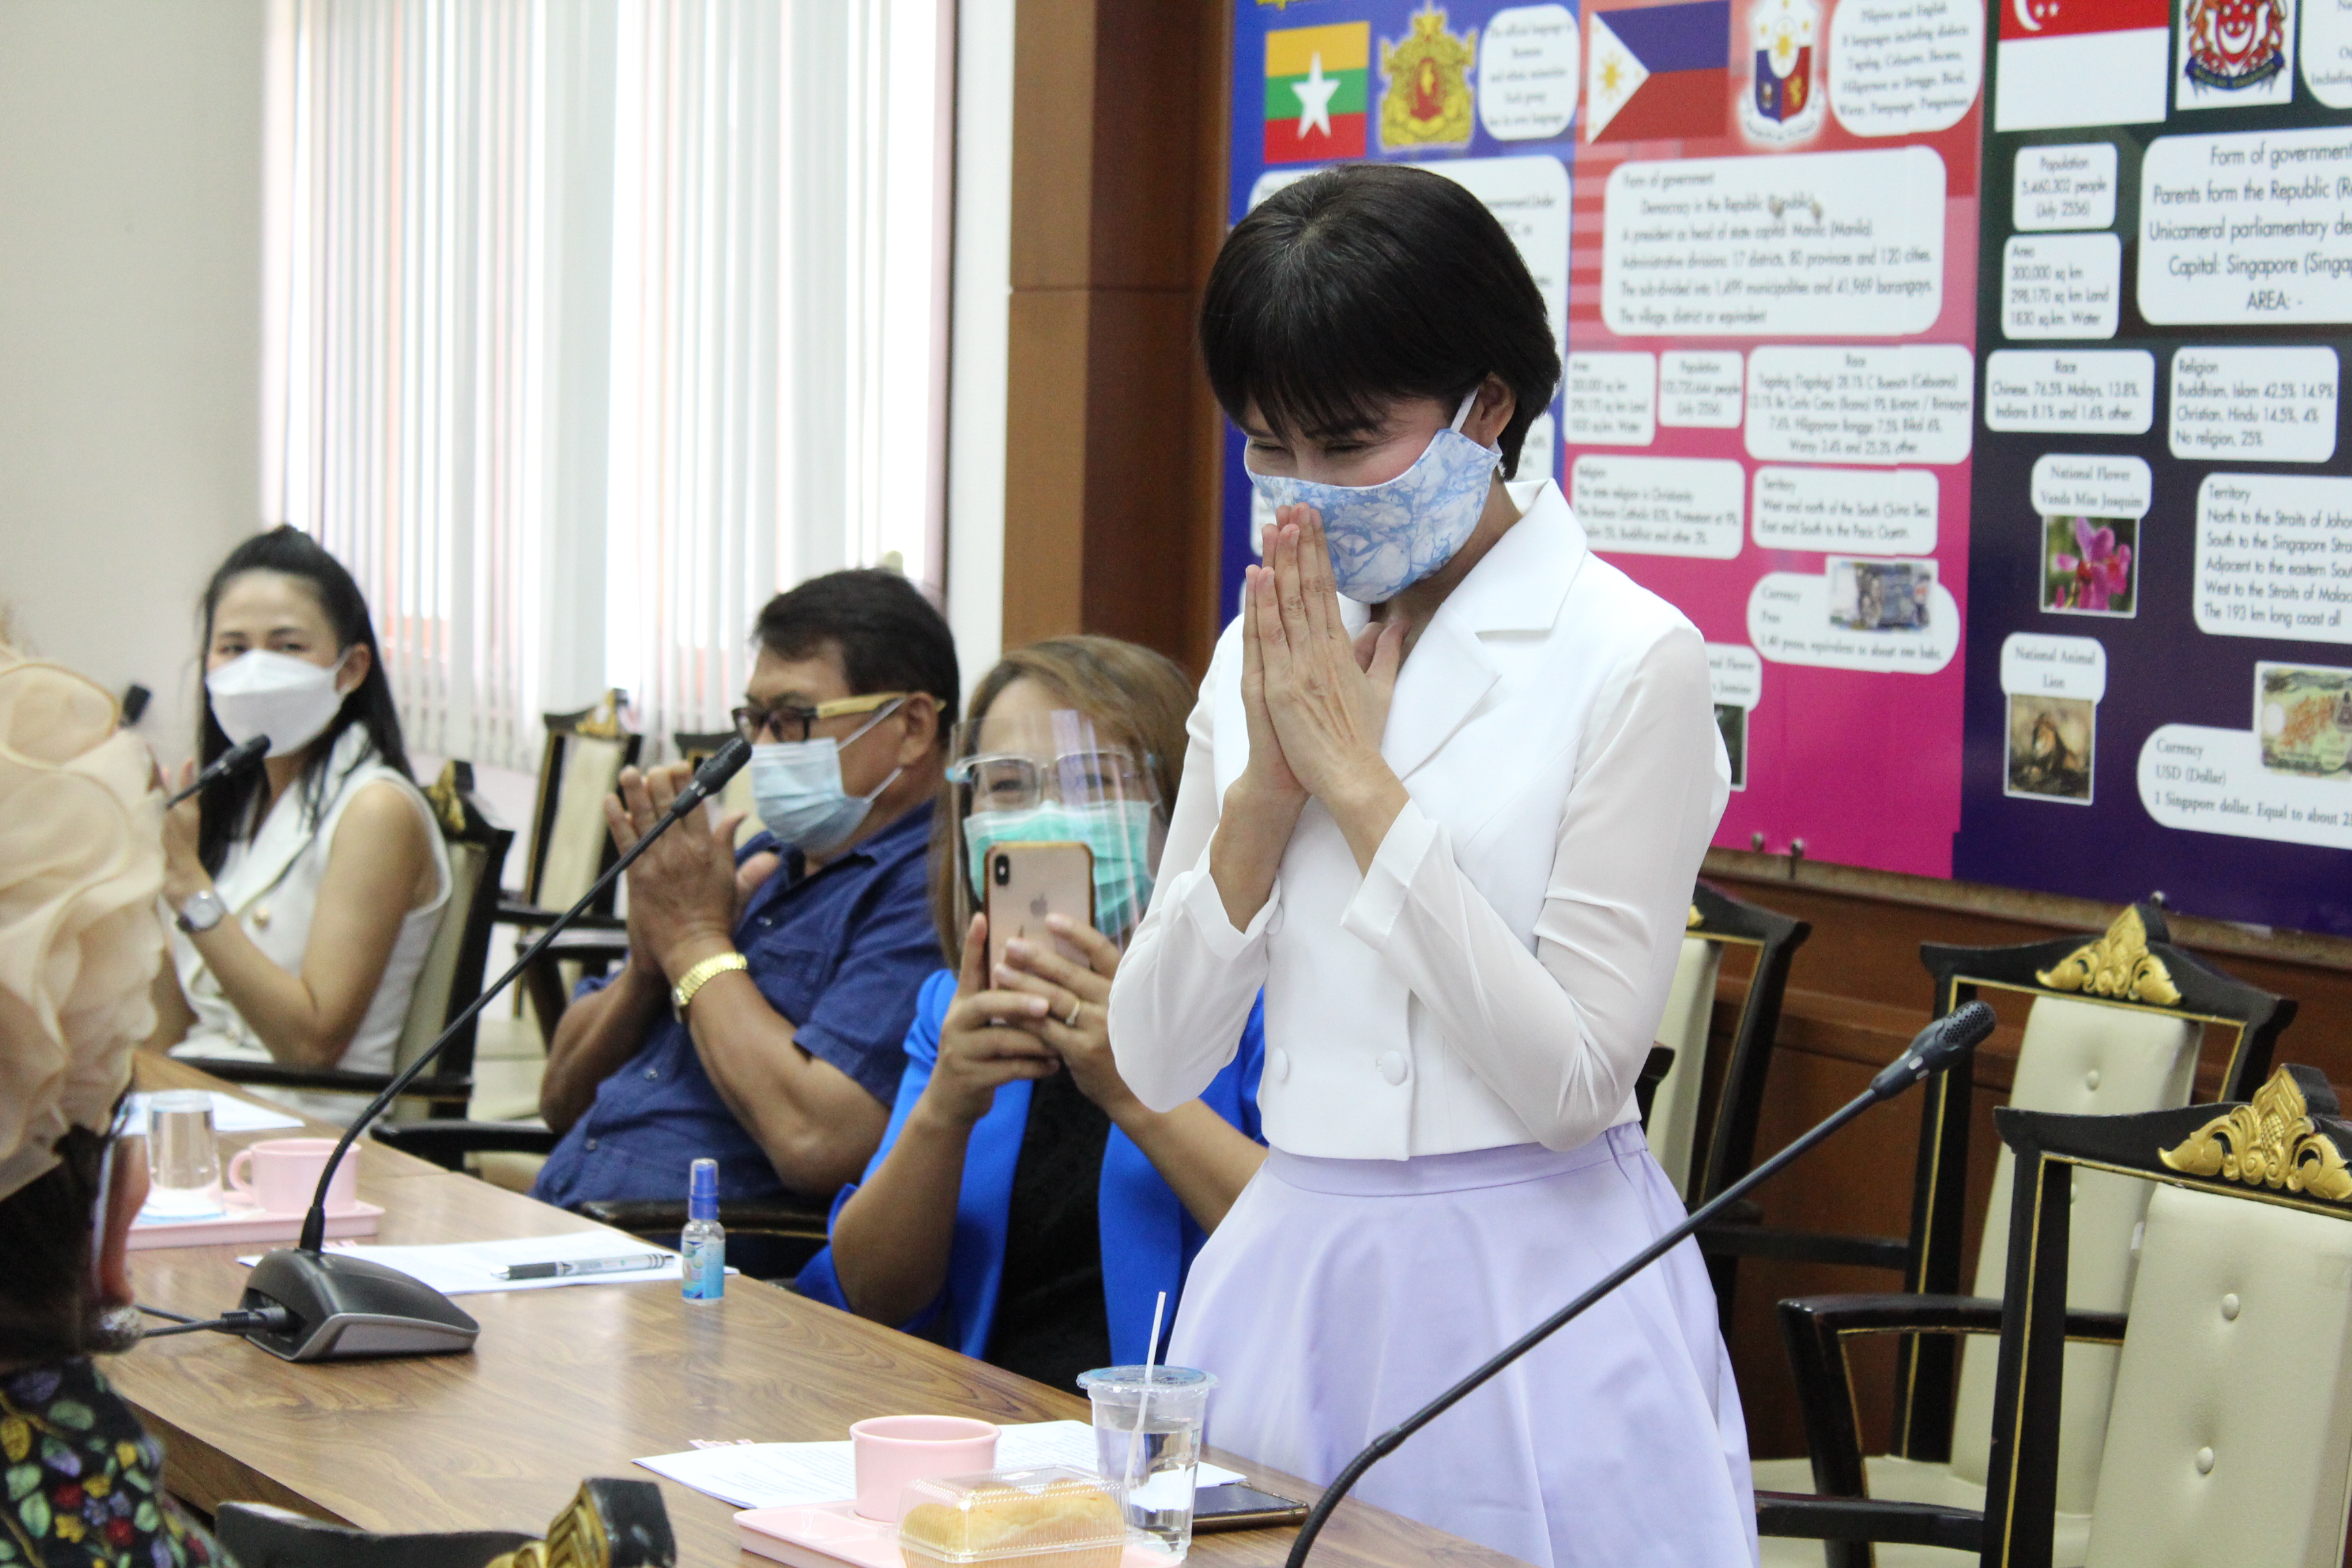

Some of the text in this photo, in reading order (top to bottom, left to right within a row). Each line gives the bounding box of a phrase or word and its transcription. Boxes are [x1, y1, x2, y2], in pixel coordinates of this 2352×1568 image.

[2040, 154, 2089, 173] Population
[2210, 140, 2352, 169] Form of government
[1663, 172, 1716, 191] government
[2074, 175, 2108, 197] people
[2153, 184, 2201, 206] Parents
[2208, 180, 2238, 201] form
[2244, 178, 2265, 201] the
[2270, 176, 2330, 206] Republic
[1642, 199, 1690, 216] Democracy
[2149, 216, 2226, 241] Unicameral
[2231, 215, 2328, 245] parliamentary
[1857, 247, 1877, 265] and
[2012, 244, 2035, 258] Area
[2068, 263, 2084, 280] km
[2168, 252, 2221, 282] Capital:
[2226, 254, 2298, 281] Singapore
[1814, 276, 1833, 293] and
[2068, 287, 2083, 303] km
[2086, 285, 2110, 303] Land
[2245, 289, 2291, 311] AREA:
[2071, 310, 2102, 326] Water
[1845, 353, 1867, 368] Race
[2054, 358, 2078, 374] Race
[2178, 358, 2219, 378] Religion
[2233, 382, 2259, 399] Islam
[2059, 404, 2077, 420] and
[2227, 405, 2259, 423] Hindu
[2302, 407, 2319, 424] 4%
[2176, 429, 2191, 446] No
[2240, 430, 2264, 447] 25%
[2050, 465, 2132, 482] National Flower
[2208, 484, 2252, 505] Territory
[2208, 507, 2322, 527] North to the Straits of
[2206, 531, 2235, 549] South
[2239, 534, 2249, 549] to
[2253, 530, 2268, 550] the
[2272, 534, 2327, 557] Singapore
[2205, 555, 2326, 576] Adjacent to the eastern
[2204, 579, 2315, 600] West to the Straits of
[2204, 602, 2342, 629] The 193 km long coast all
[2016, 646, 2096, 666] National Animal
[2043, 673, 2065, 689] Lion
[2155, 738, 2205, 762] Currency
[2155, 764, 2227, 788] USD (Dollar)
[2155, 791, 2161, 805] 1
[2165, 791, 2216, 814] Singapore
[2220, 798, 2253, 817] dollar.
[2257, 803, 2288, 823] Equal
[2291, 808, 2303, 821] to
[2307, 808, 2338, 826] about
